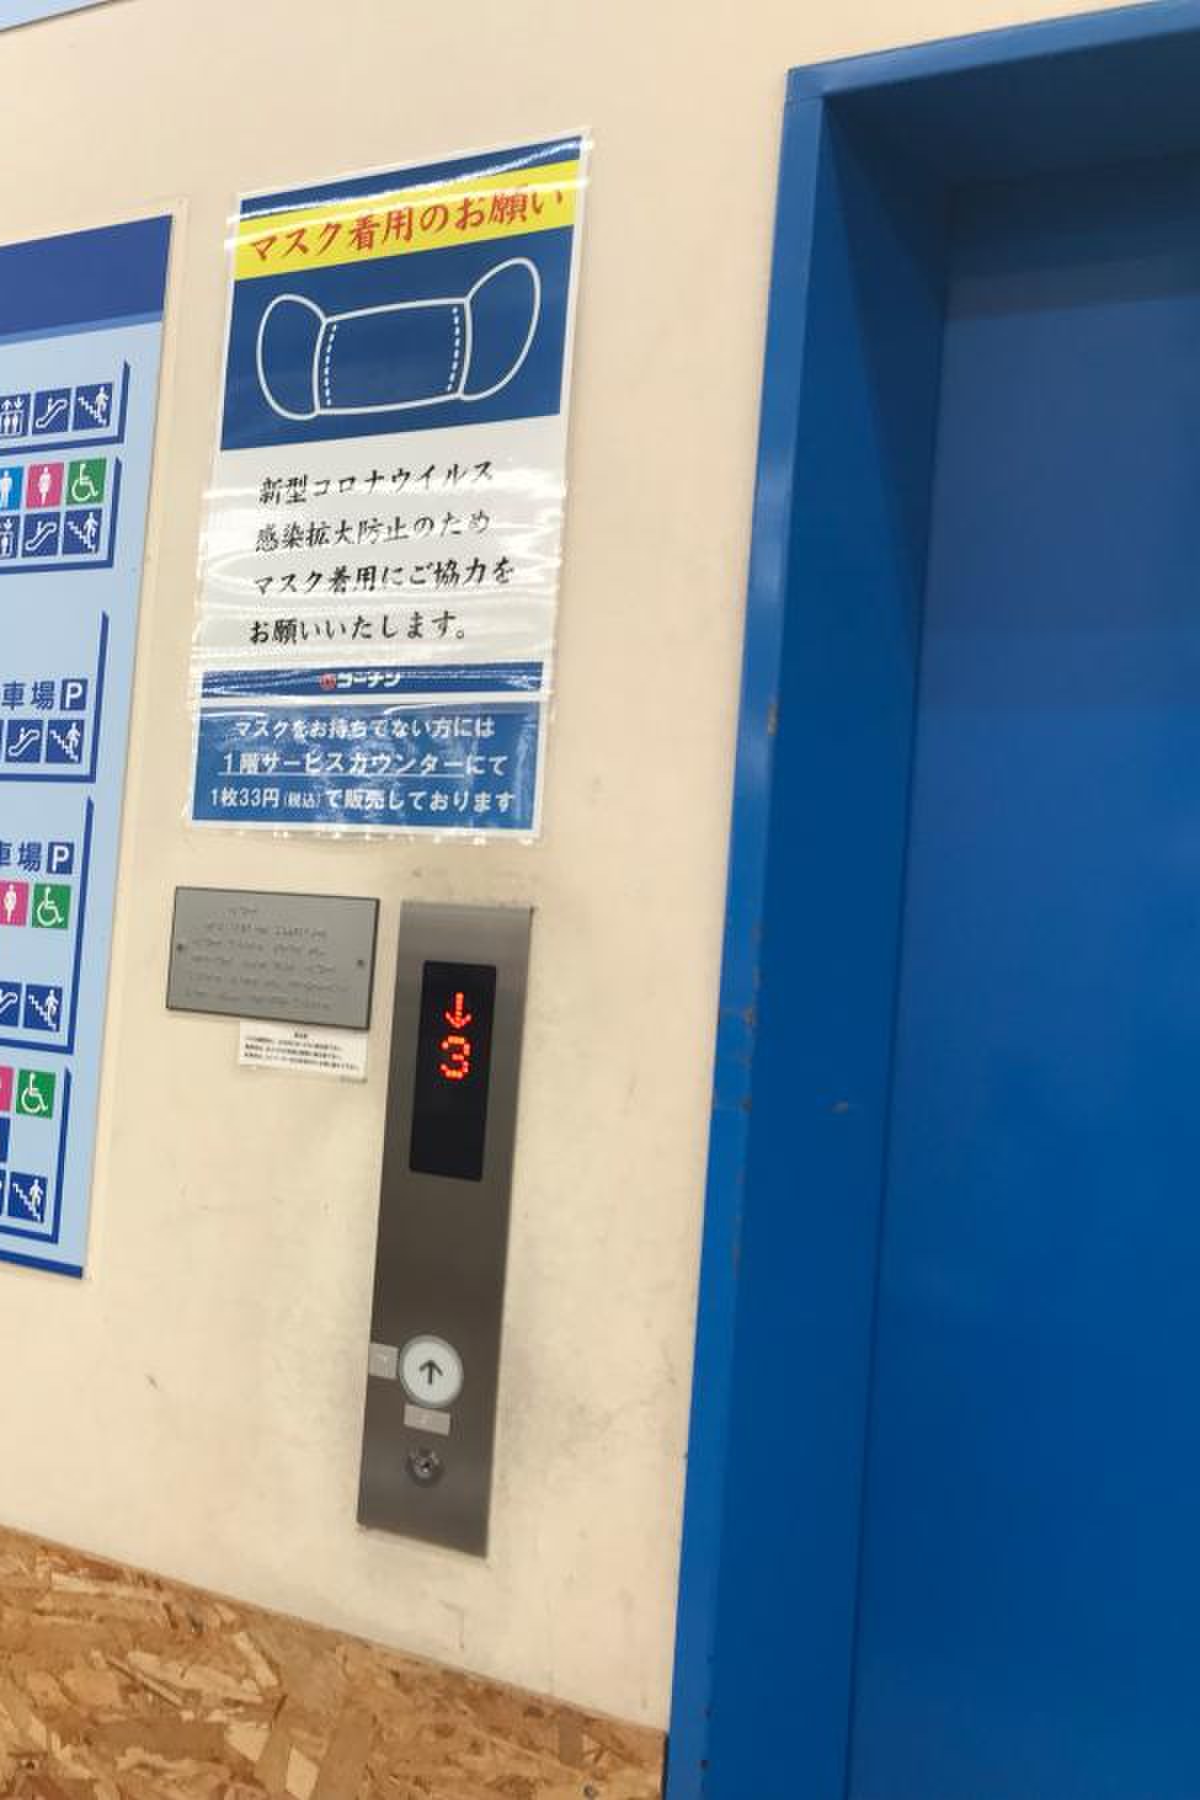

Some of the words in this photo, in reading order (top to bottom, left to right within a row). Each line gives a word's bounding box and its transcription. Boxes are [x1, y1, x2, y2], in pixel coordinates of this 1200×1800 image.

[250, 187, 563, 262] マスク着用のお願い
[258, 460, 494, 506] 新型コロナウイルス
[254, 509, 491, 553] 感染拡大防止のため
[254, 556, 516, 596] マスク着用にご協力を
[249, 610, 466, 646] お願いいたします。
[335, 672, 402, 689] コーナン
[234, 717, 495, 739] マスクをお持ちでない方には
[223, 752, 510, 776] 1階サービスカウンターにて
[440, 1035, 471, 1081] 3
